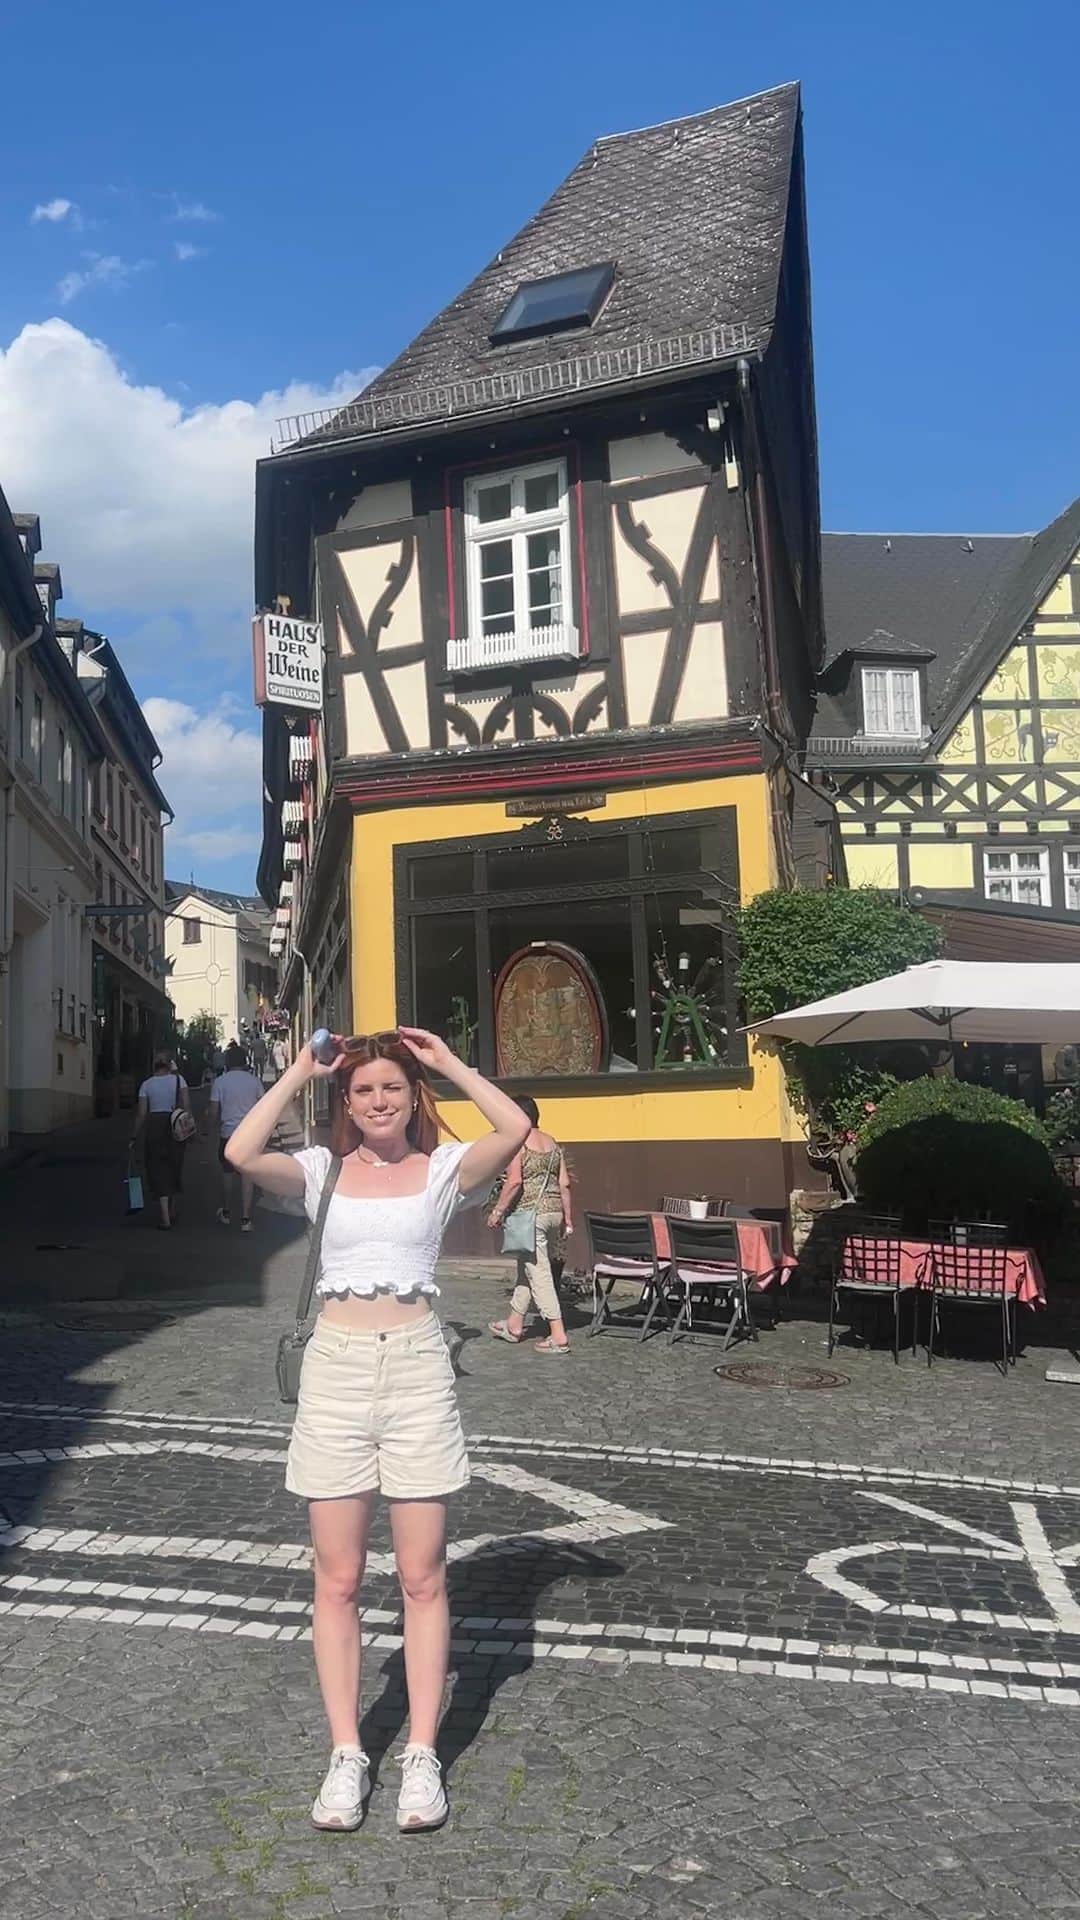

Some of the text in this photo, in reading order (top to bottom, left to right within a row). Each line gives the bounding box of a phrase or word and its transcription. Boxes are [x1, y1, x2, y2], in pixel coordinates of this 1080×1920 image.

[269, 619, 317, 644] HAUS
[278, 640, 309, 658] DER
[268, 652, 320, 683] Weine
